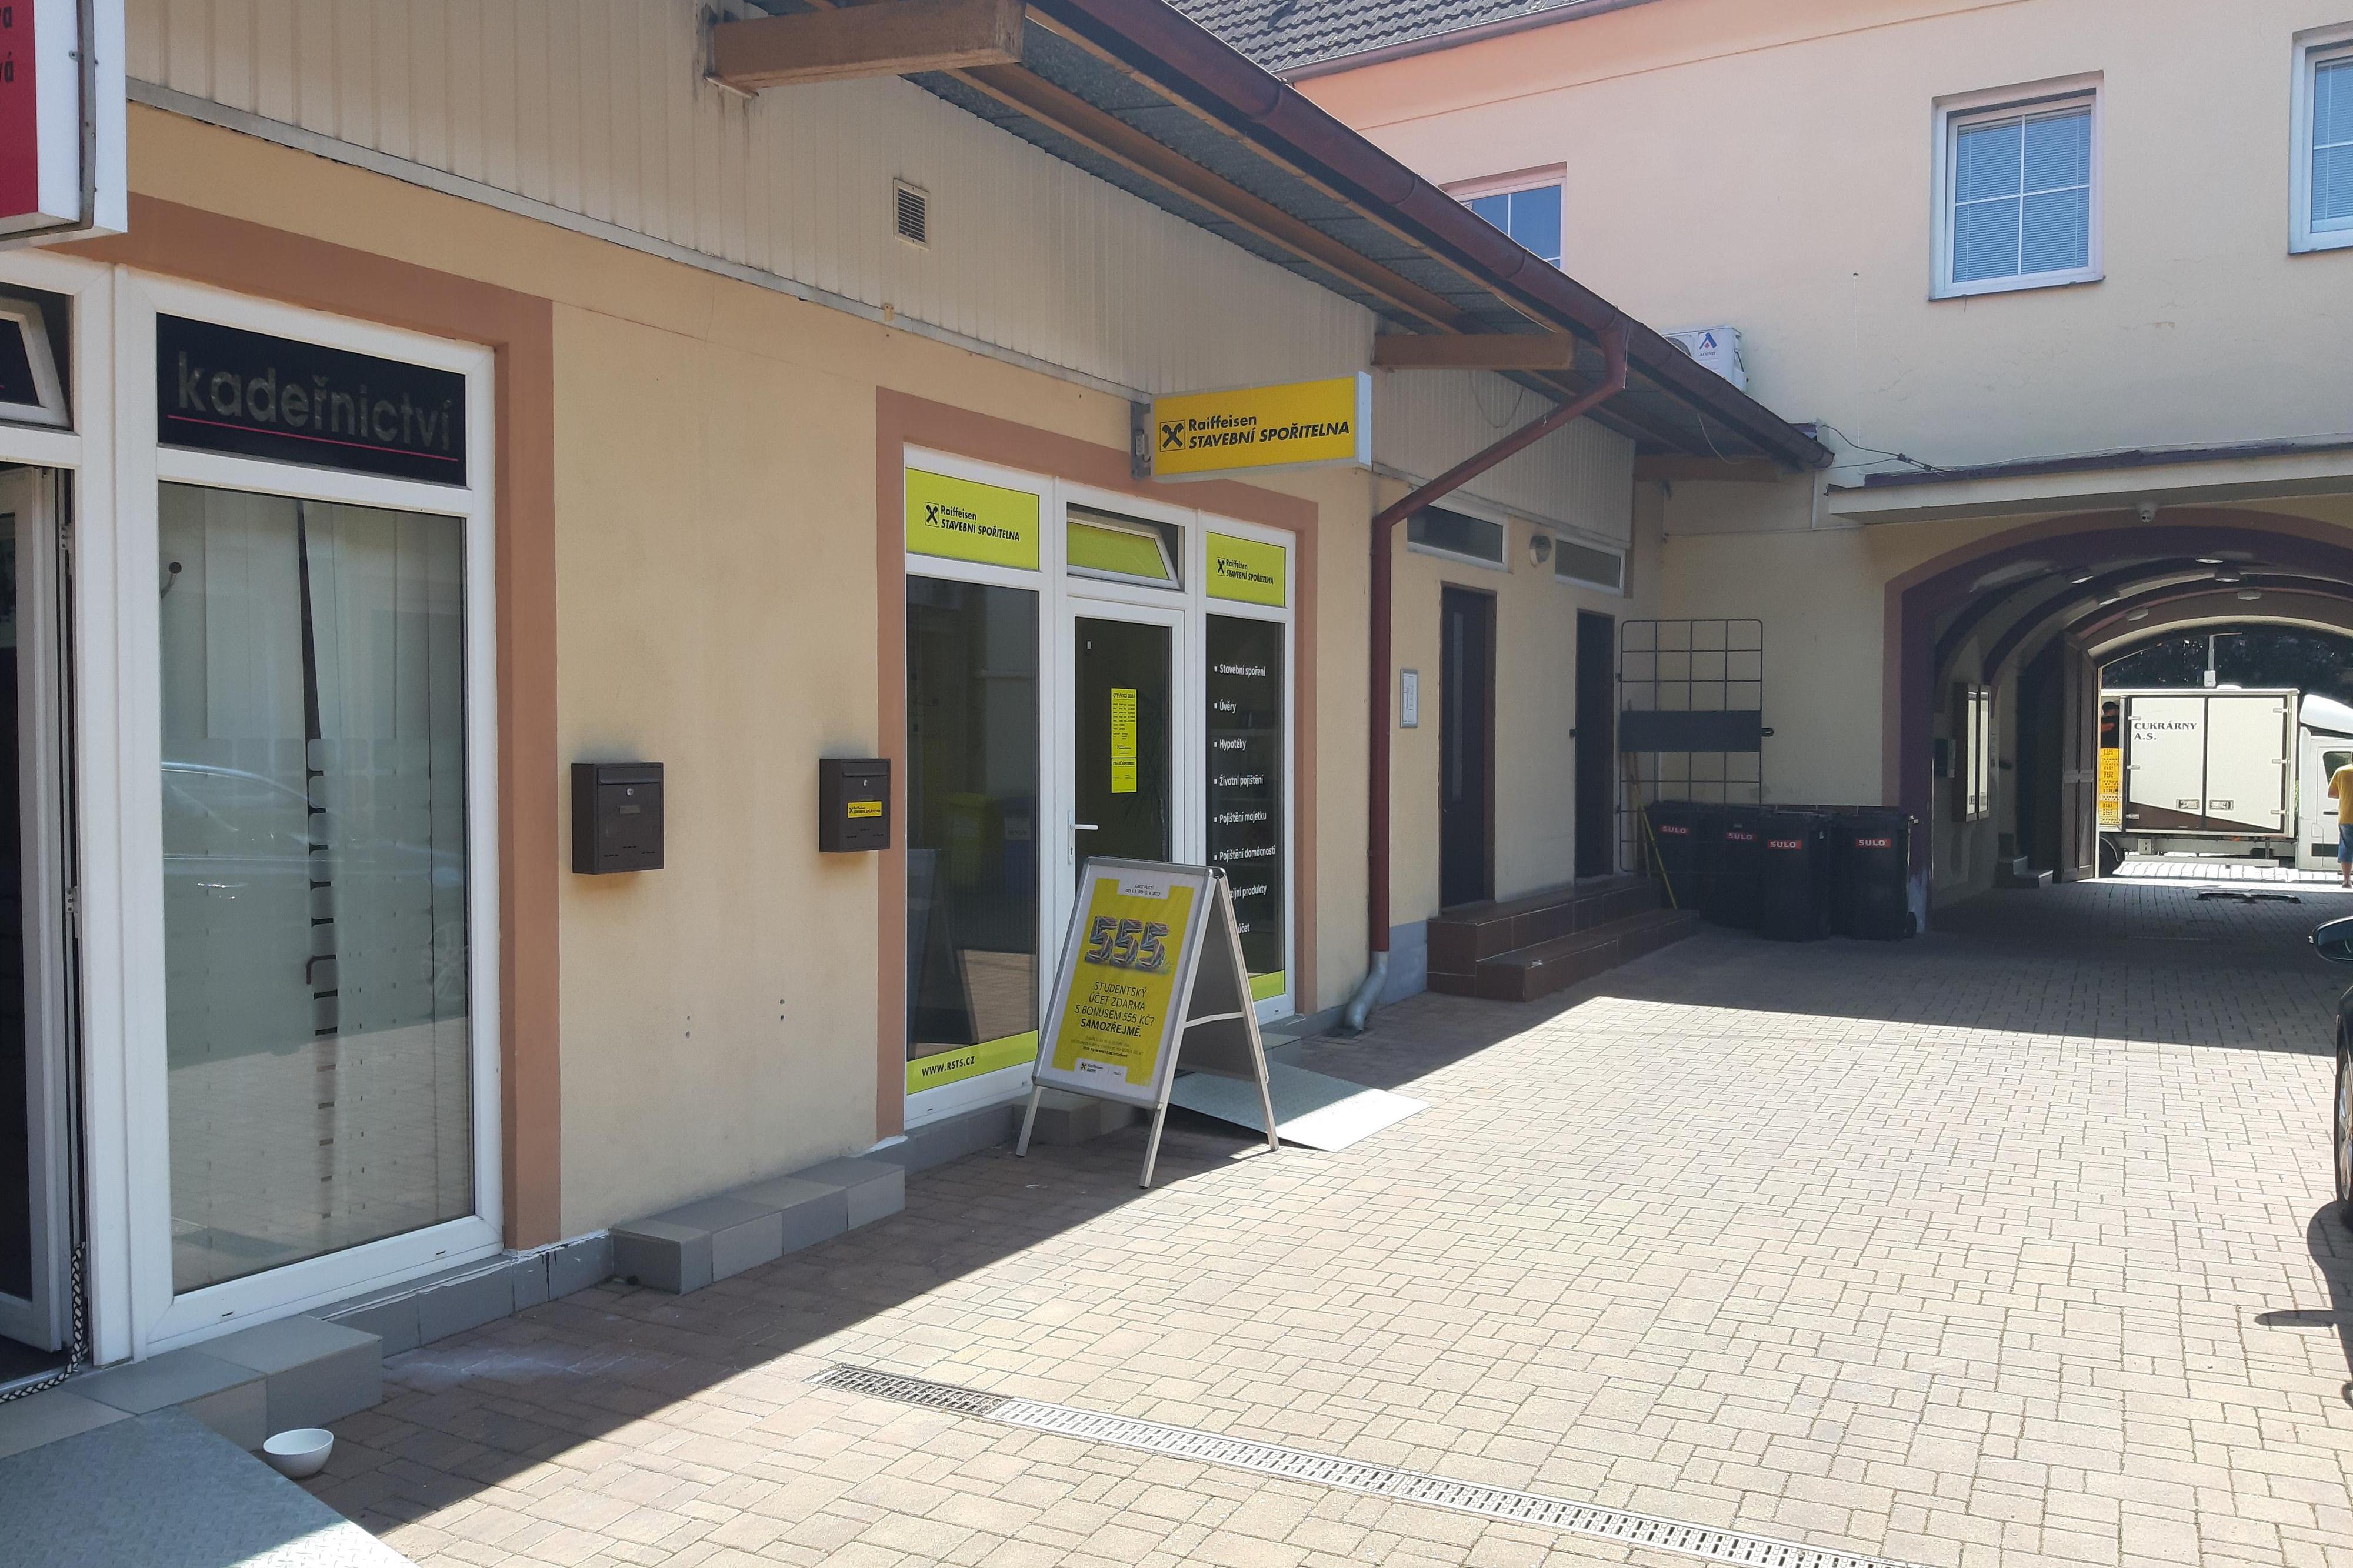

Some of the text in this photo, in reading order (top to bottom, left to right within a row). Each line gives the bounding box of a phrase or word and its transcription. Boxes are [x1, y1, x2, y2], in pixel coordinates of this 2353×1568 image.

[179, 351, 452, 451] kadeřnictví
[1188, 414, 1257, 432] Raiffeisen
[1188, 421, 1349, 449] STAVEBNÍ SPOŘITELNA
[941, 505, 976, 521] Raiffeisen
[941, 519, 1020, 541] STAVEBNÍ SPOŘITELNA
[1226, 559, 1248, 570] Raiffeisen
[1226, 569, 1274, 585] STAVEBNÍ SPOŘITELNA
[1219, 663, 1266, 678] Stavební spoření
[1219, 699, 1237, 714] Úvěry
[2134, 720, 2198, 730] CUKRÁRNY
[1219, 738, 1247, 751] Hypotéky
[2134, 733, 2157, 741] A.S.
[1219, 774, 1264, 788] Životní pojištění
[1219, 810, 1267, 826] Pojištění majetku
[1662, 825, 1687, 834] SULO
[1728, 832, 1753, 840] SULO
[1219, 844, 1276, 863] Pojištění domácnosti
[1229, 884, 1267, 900] zijní produkty
[1238, 923, 1250, 934] účet
[1084, 915, 1169, 970] 555
[1094, 981, 1147, 998] STUDENTSKÝ
[1089, 991, 1145, 1011] ÚČET ZDARMA
[1074, 1004, 1155, 1026] S BONUSEM 555 KČ?
[1081, 1018, 1141, 1037] SAMOZŘEJMĚ.
[921, 1056, 975, 1077] WWW.RSTS.CZ
